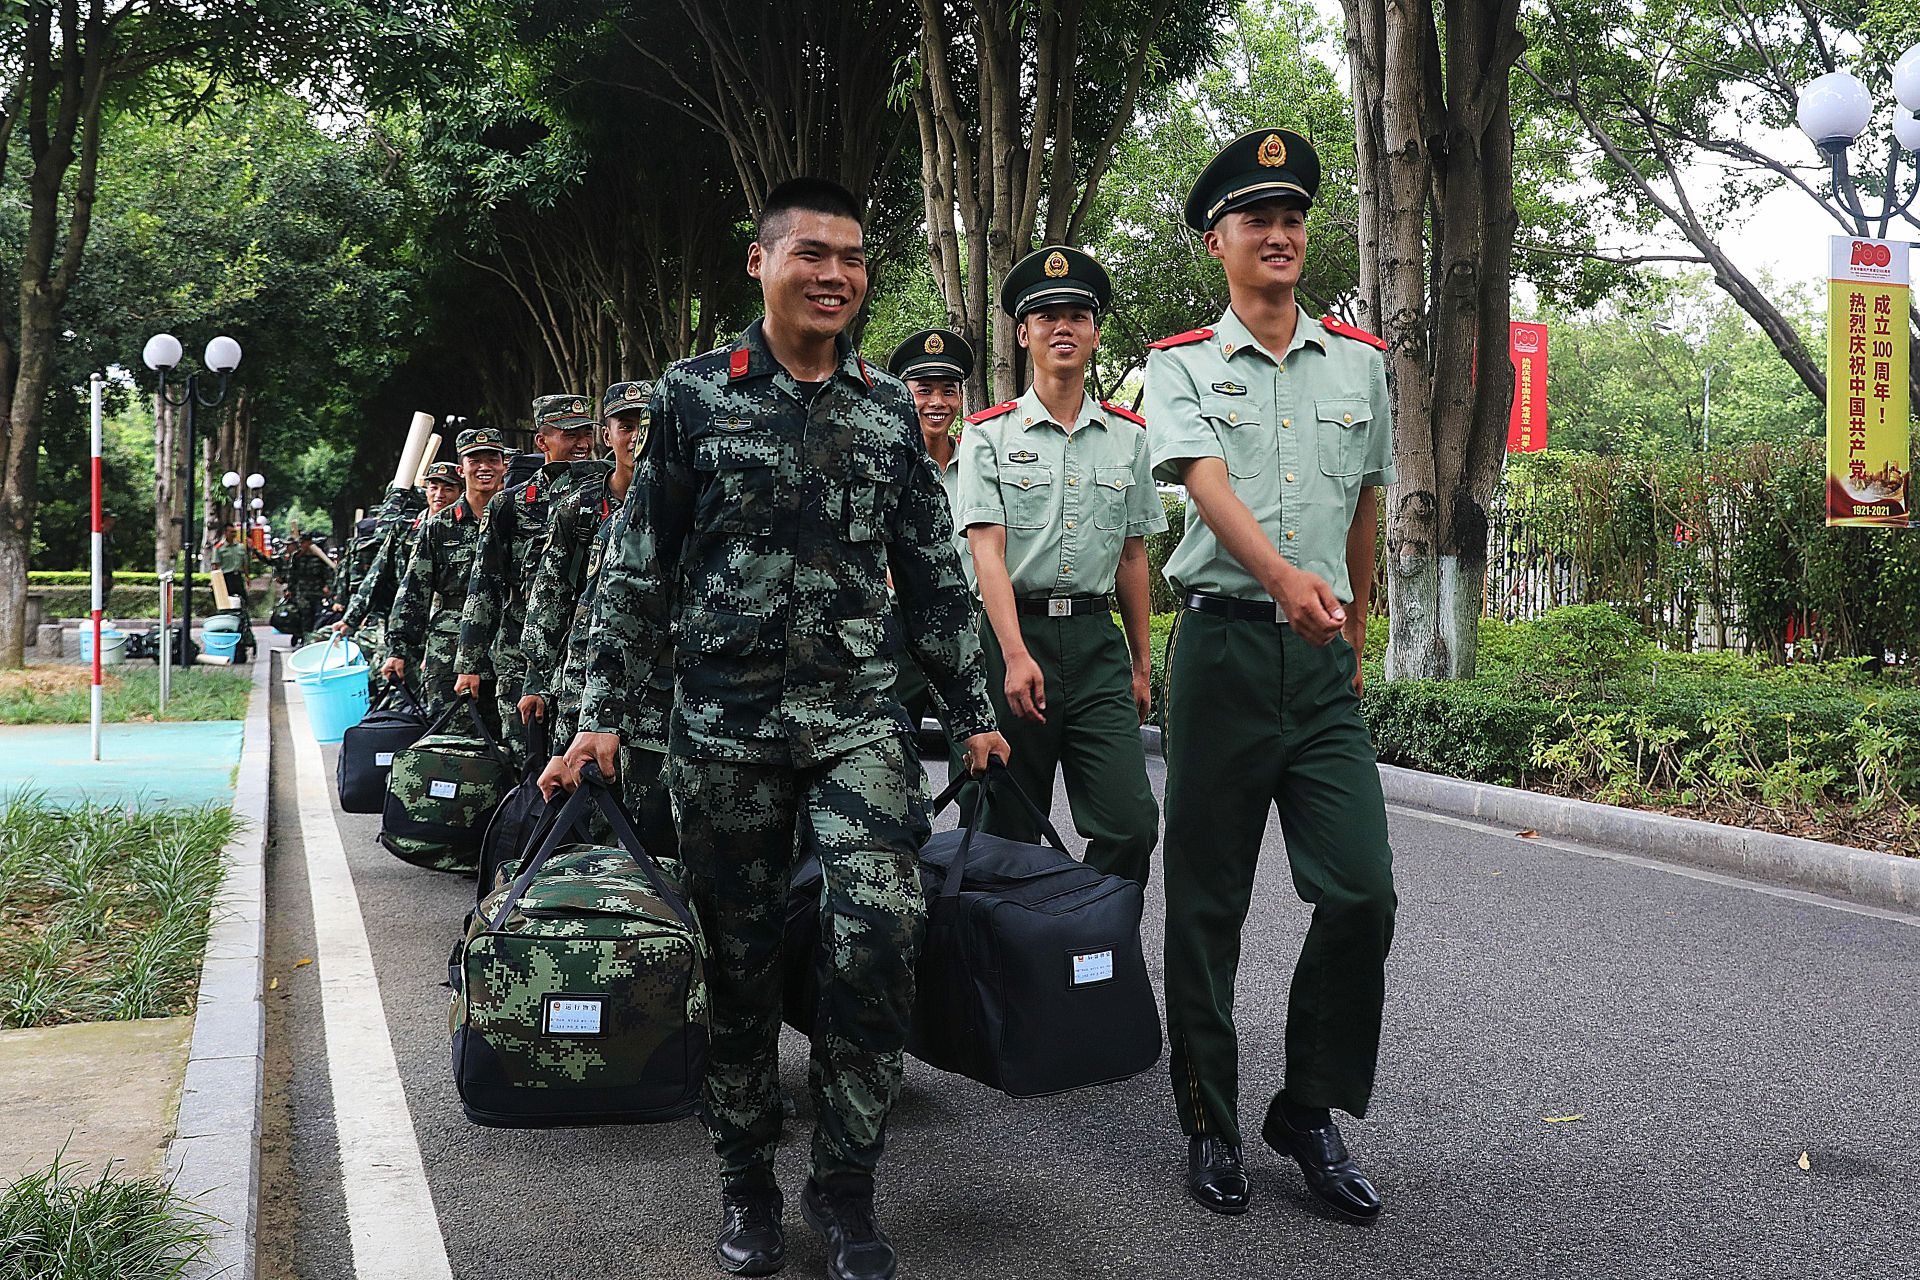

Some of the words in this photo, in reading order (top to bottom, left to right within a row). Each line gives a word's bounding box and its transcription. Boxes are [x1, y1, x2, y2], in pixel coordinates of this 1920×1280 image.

[1849, 292, 1867, 480] 热烈庆祝中国共产党
[1852, 505, 1889, 516] 1921-2021
